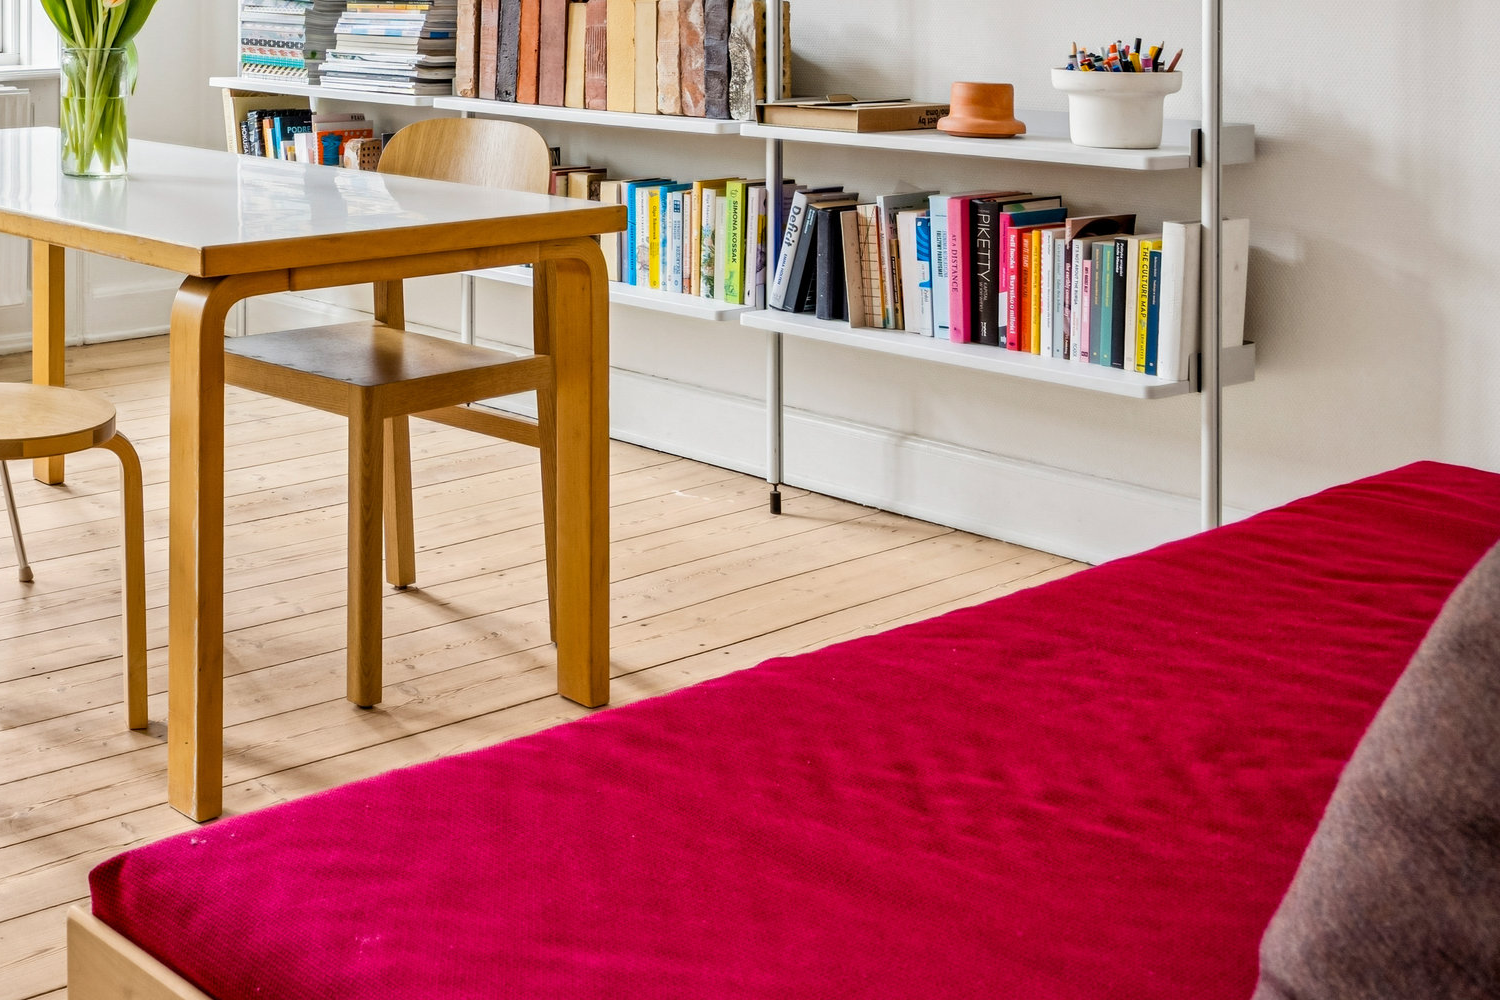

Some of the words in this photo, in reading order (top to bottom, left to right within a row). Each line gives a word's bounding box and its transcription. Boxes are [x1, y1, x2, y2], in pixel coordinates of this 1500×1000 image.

[287, 125, 311, 134] PODRE
[918, 116, 926, 126] by
[785, 205, 801, 247] Deficit
[976, 213, 990, 281] PIKETTY
[1140, 263, 1148, 297] CULTURE
